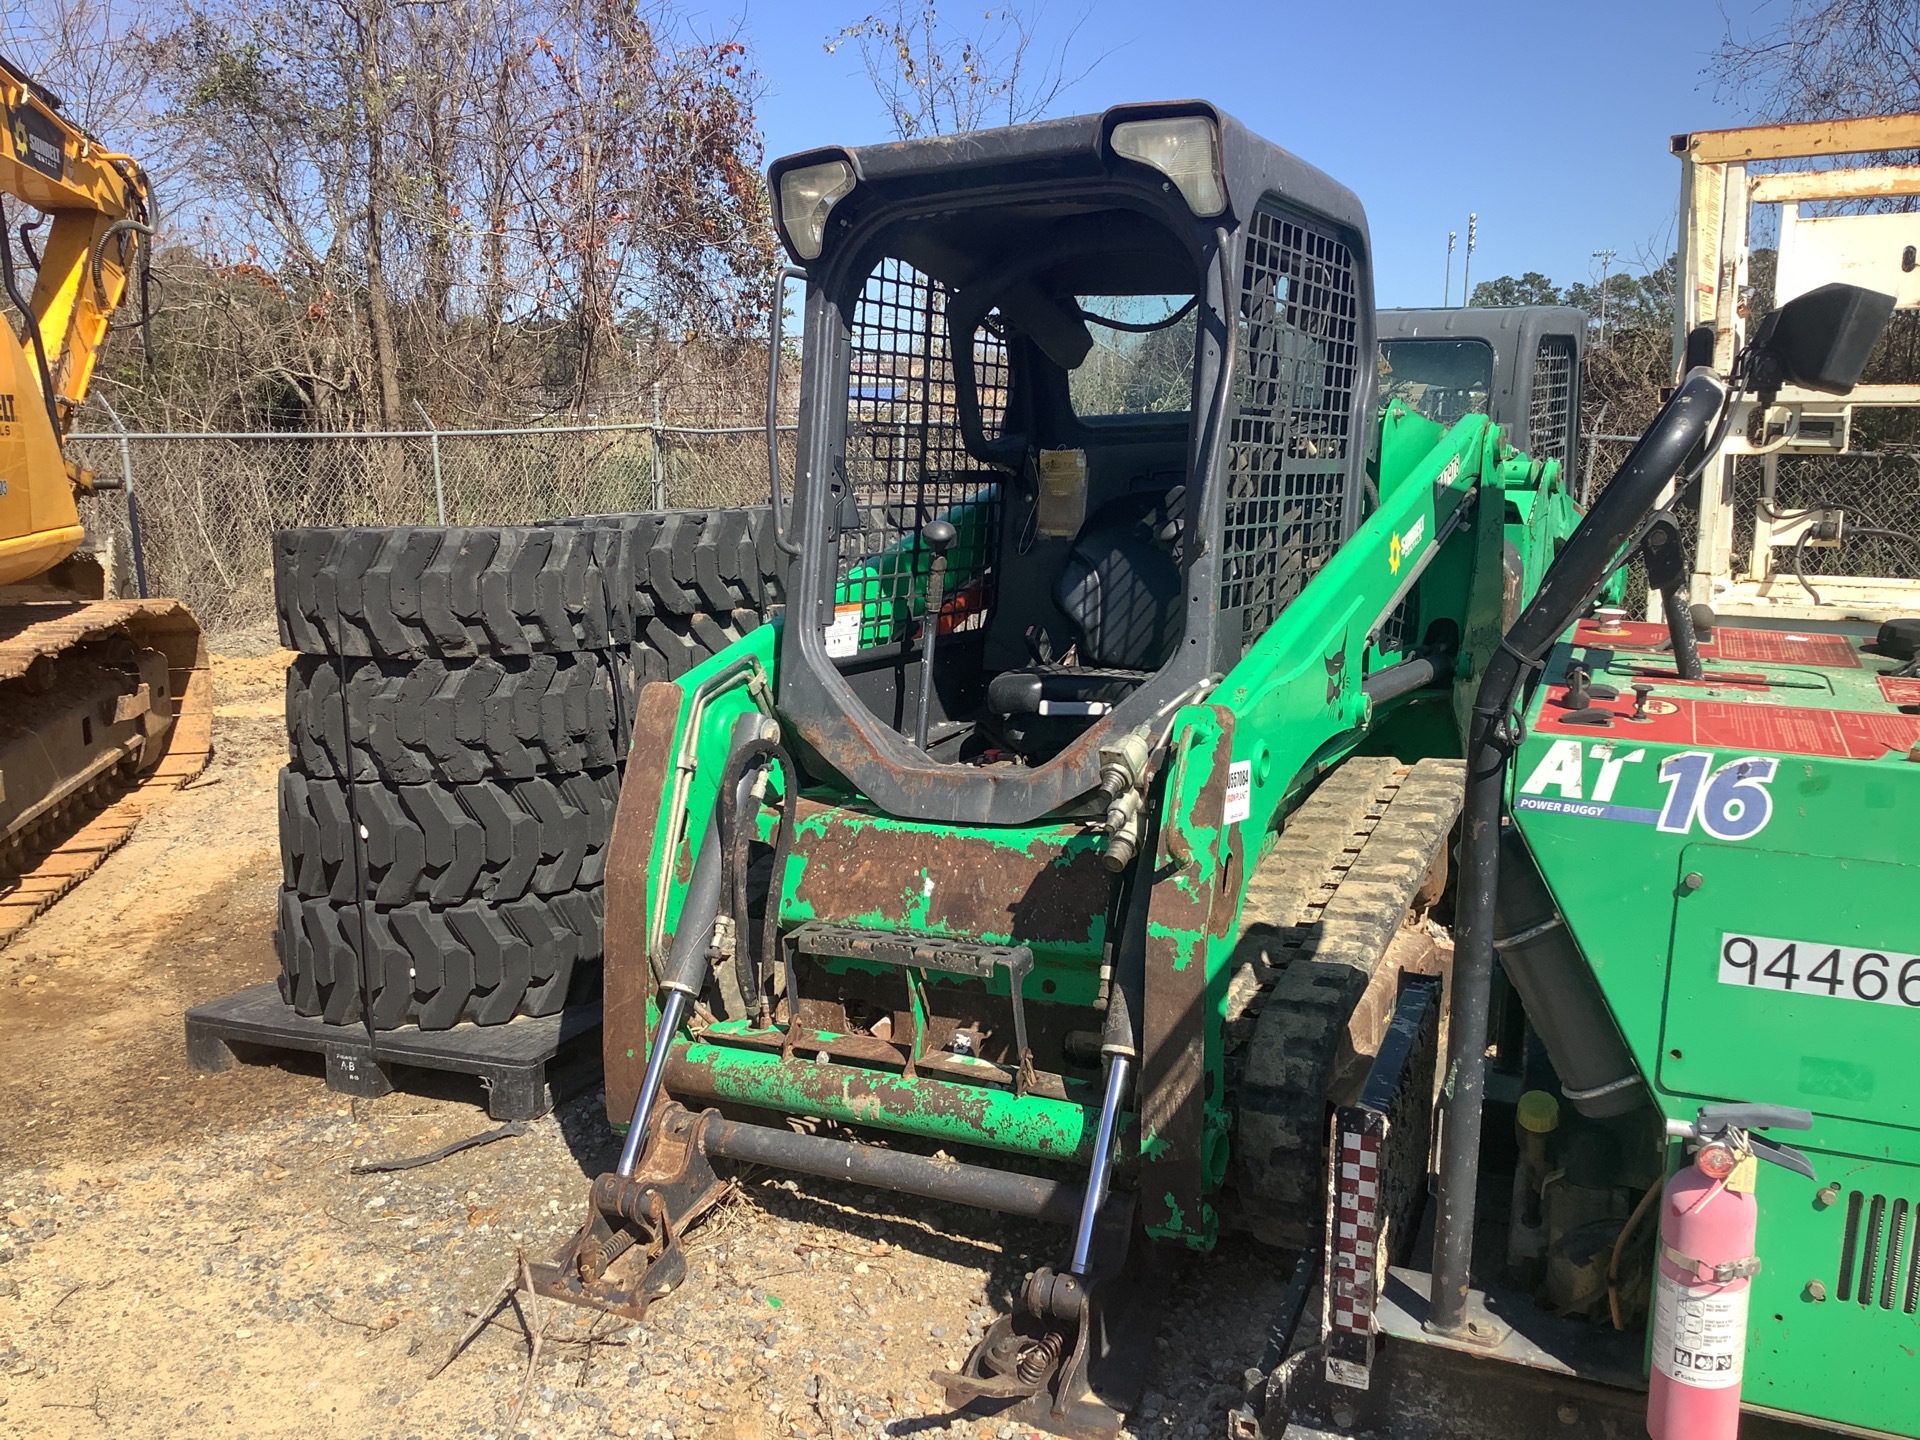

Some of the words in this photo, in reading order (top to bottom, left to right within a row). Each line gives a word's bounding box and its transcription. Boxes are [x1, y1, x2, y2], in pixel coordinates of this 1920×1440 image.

[1519, 739, 1646, 803] AT
[1656, 750, 1780, 841] 16
[1520, 798, 1561, 812] POWER
[1562, 803, 1605, 817] BUGGY
[1723, 937, 1920, 1007] 94466
